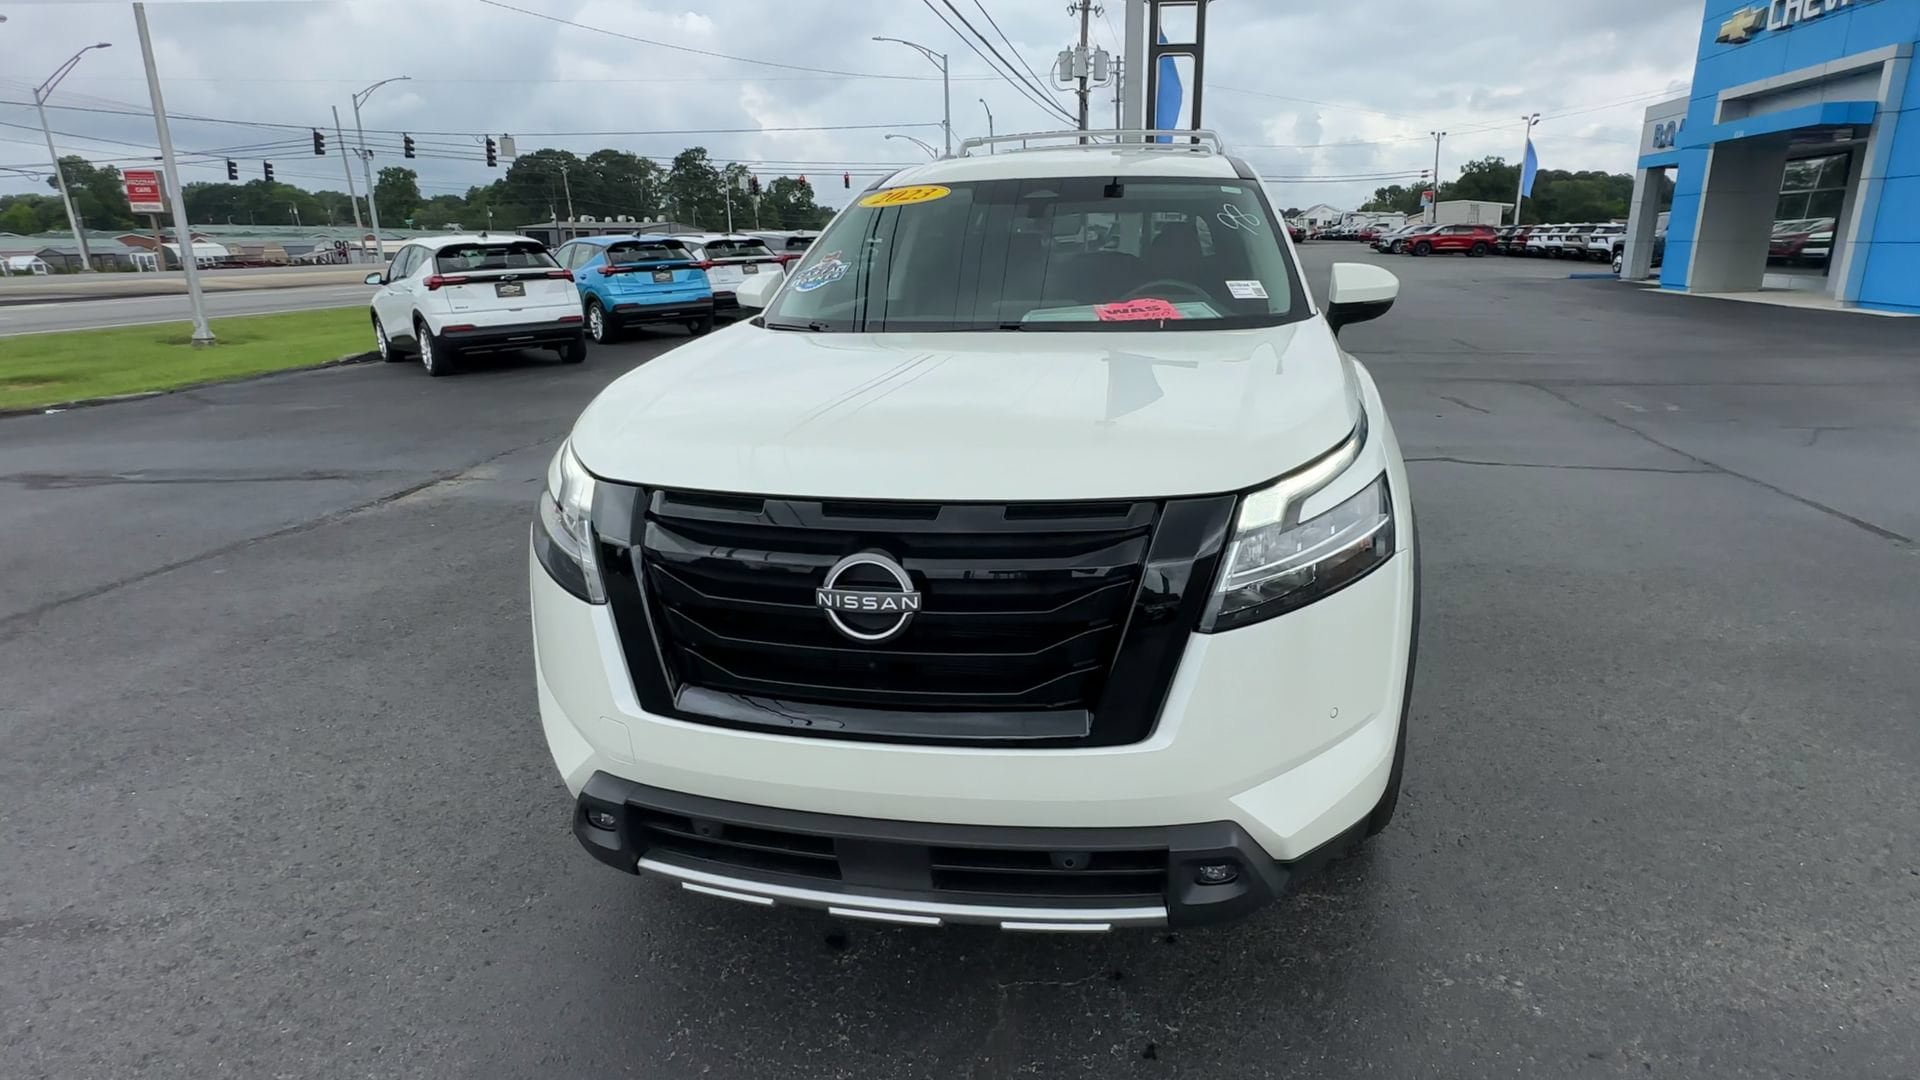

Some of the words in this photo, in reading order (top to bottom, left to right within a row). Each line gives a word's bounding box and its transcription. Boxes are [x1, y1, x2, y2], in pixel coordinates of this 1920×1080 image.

[1767, 0, 1850, 31] CHE
[872, 188, 937, 204] 2023
[818, 592, 918, 610] NISSAN
